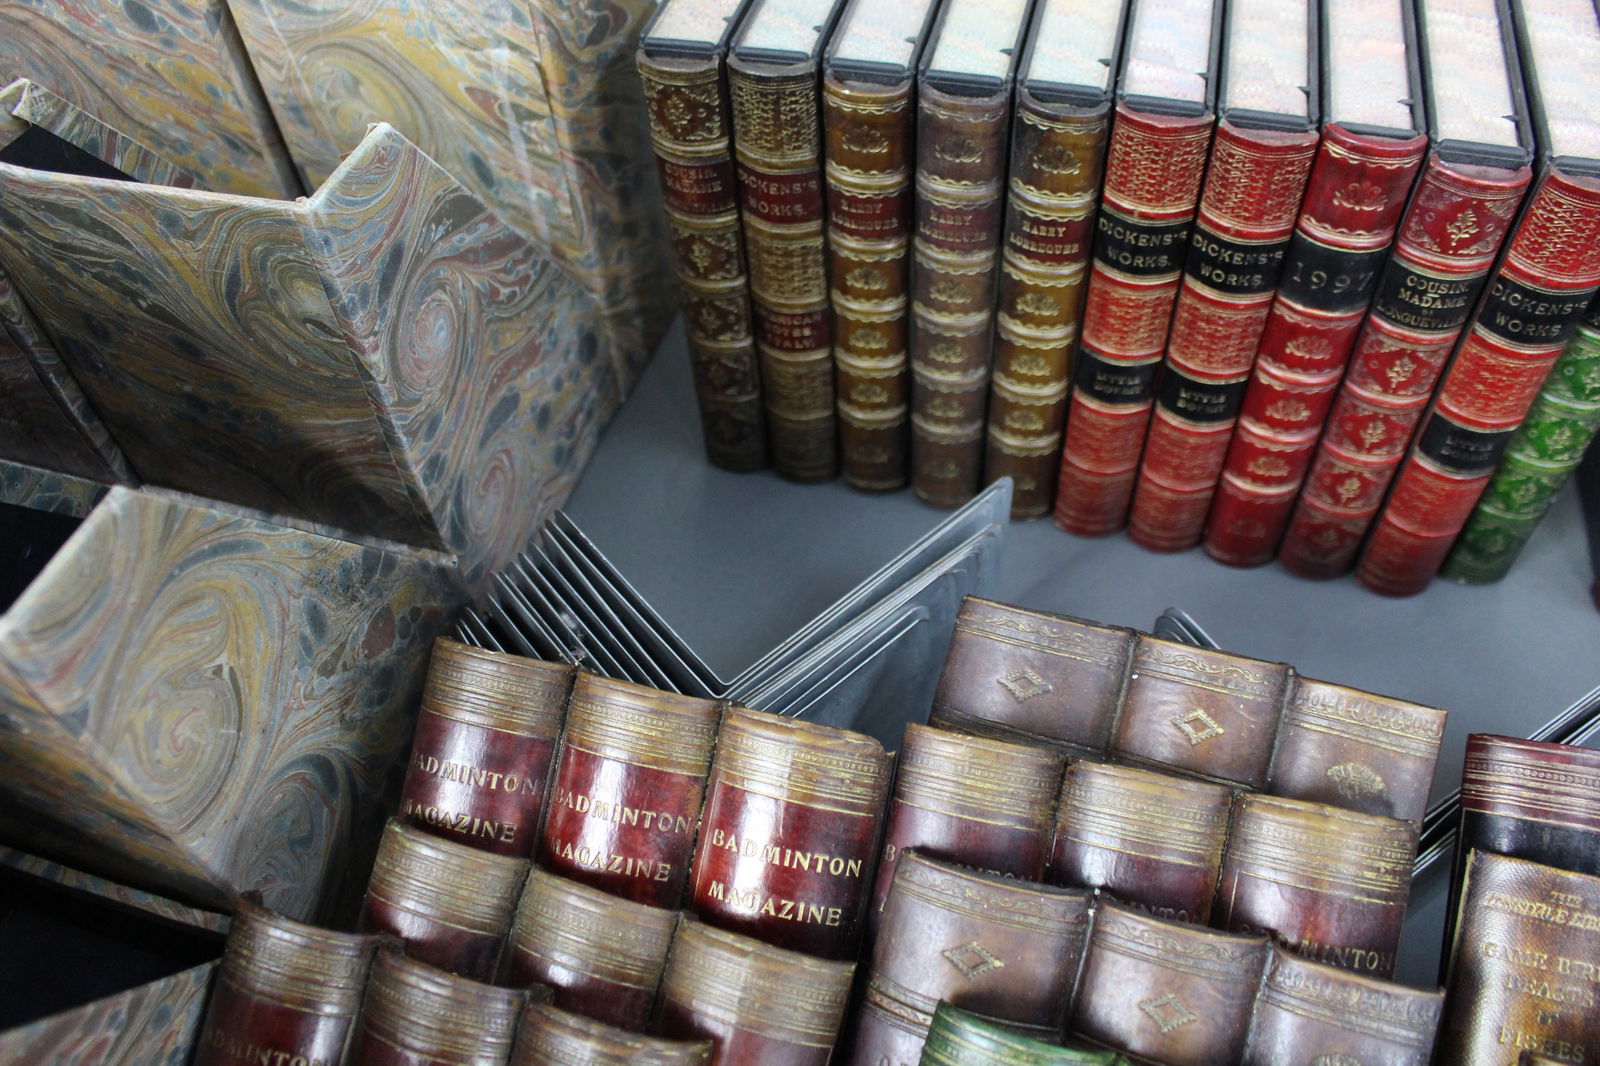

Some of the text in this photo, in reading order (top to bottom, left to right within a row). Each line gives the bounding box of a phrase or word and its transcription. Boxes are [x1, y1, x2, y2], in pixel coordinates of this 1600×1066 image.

[840, 198, 883, 215] HARRY
[929, 209, 973, 226] HARRY
[1022, 219, 1067, 238] HARRY
[1098, 216, 1188, 247] DICKENS'S
[1191, 232, 1285, 267] DICKENS'S
[1291, 260, 1375, 295] 1997
[1397, 286, 1467, 310] MADAME
[1491, 281, 1589, 317] DICKENS'S
[712, 828, 864, 879] BADMINTON
[707, 879, 843, 928] MAGAZINE
